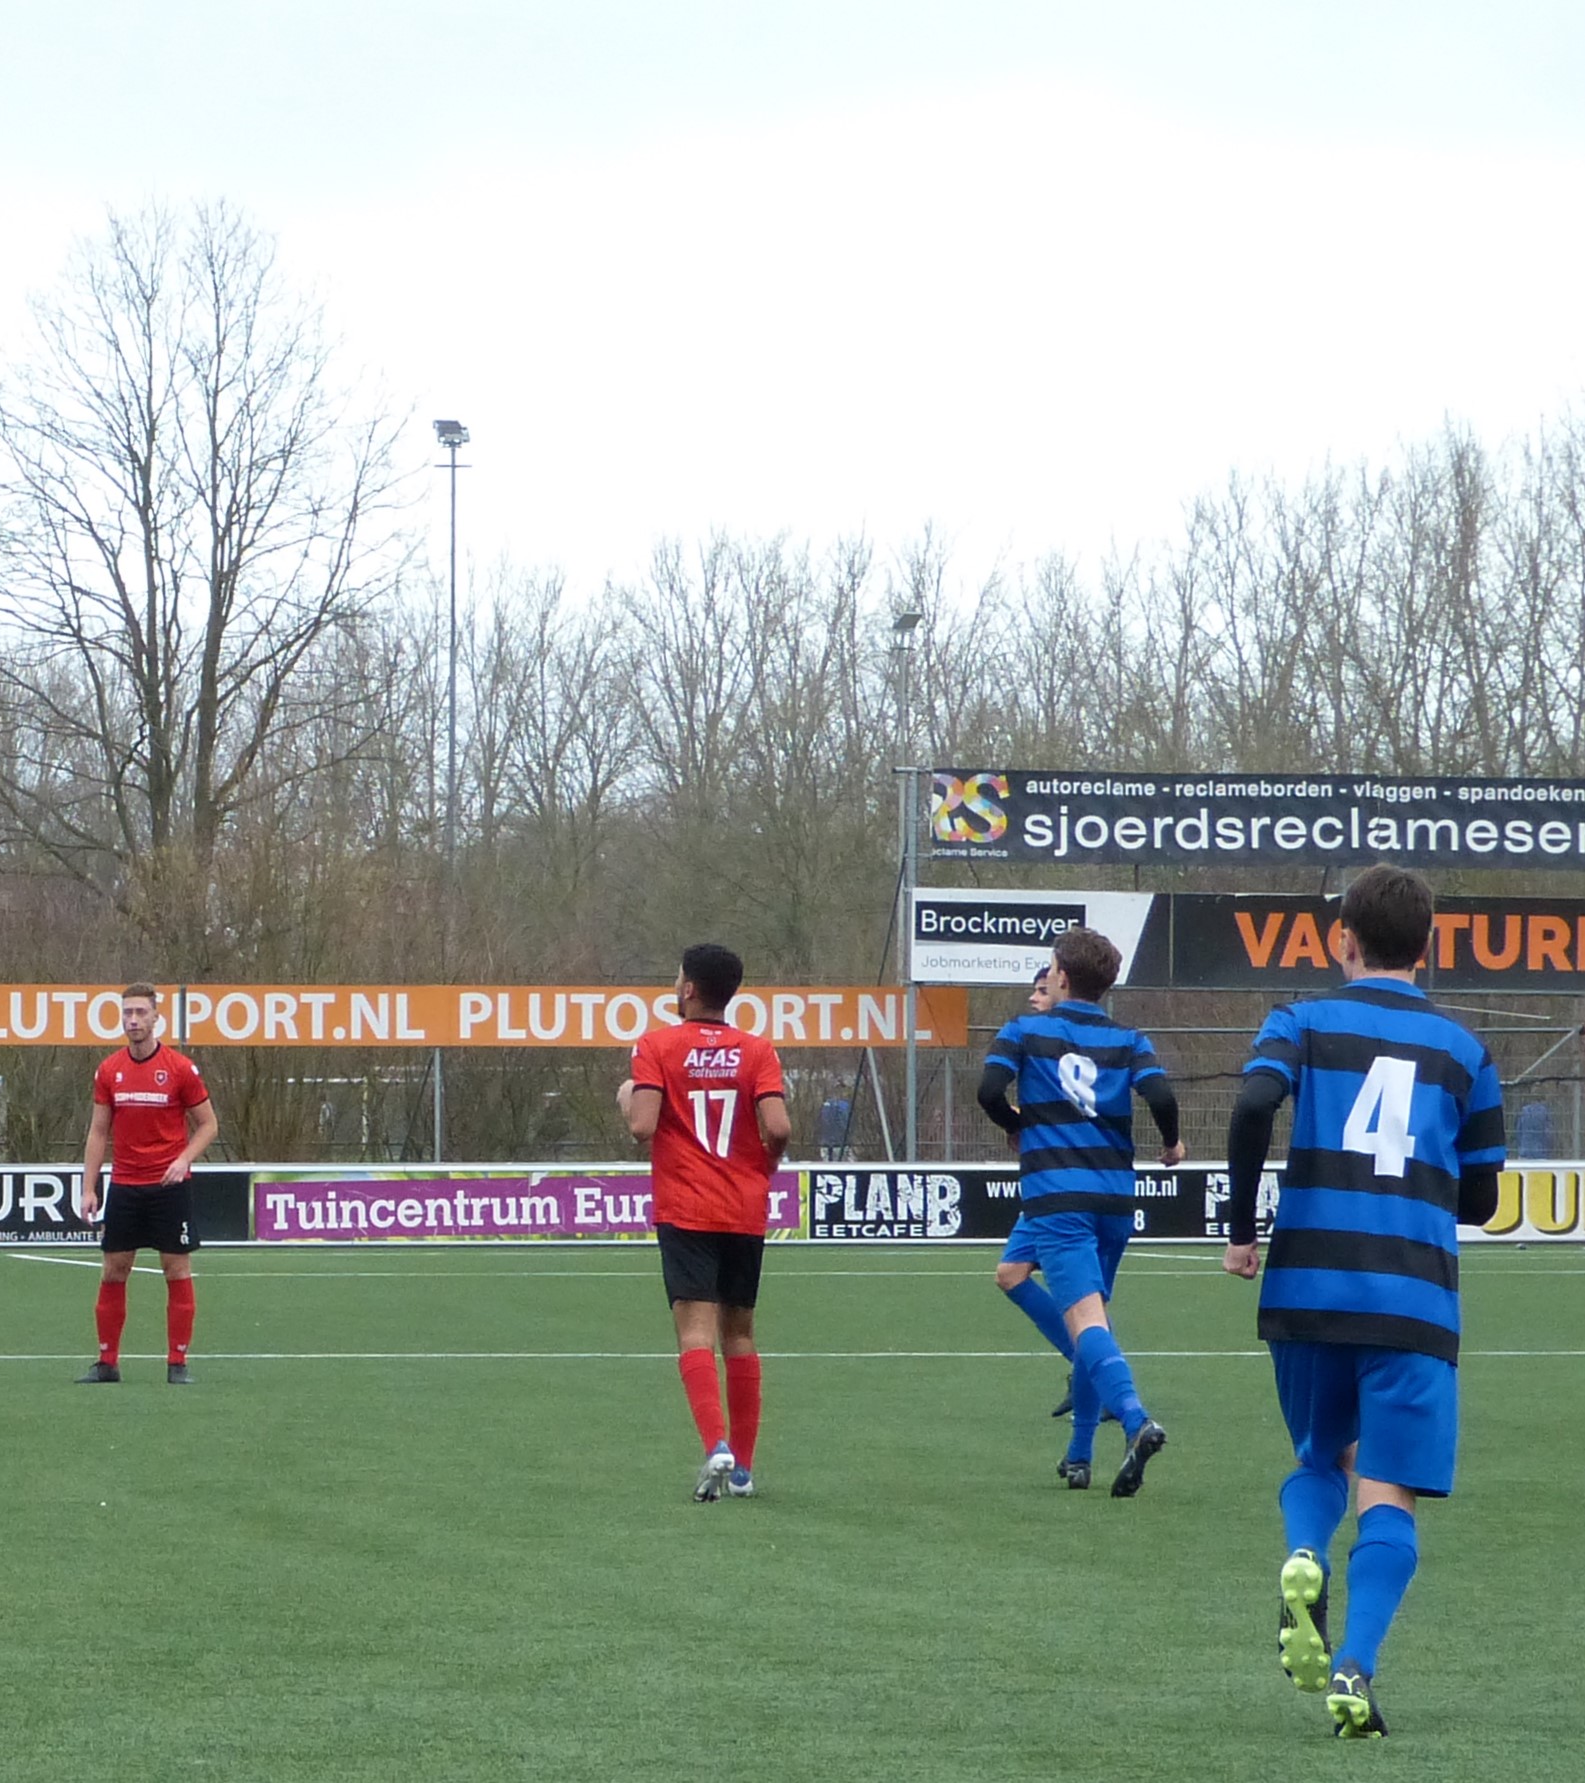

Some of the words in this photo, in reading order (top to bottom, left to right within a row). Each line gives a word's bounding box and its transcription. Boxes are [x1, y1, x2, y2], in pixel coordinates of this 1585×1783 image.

[1026, 778, 1156, 797] autoreclame
[1175, 780, 1333, 799] reclameborden
[1353, 781, 1437, 803] vlaggen
[1458, 784, 1585, 804] spandoeken
[921, 909, 1080, 941] Brockmeyer
[1234, 911, 1585, 971] VATUR
[921, 955, 1021, 973] Jobmarketing
[458, 992, 932, 1041] PLUTOSORT.NL
[683, 1048, 741, 1068] AFAS
[687, 1089, 738, 1158] 17
[1342, 1056, 1417, 1177] 4
[266, 1189, 560, 1231] Tuincentrum
[1482, 1171, 1585, 1236] JU
[28, 1231, 93, 1242] AMBULANTE
[815, 1223, 924, 1238] EETCAFE
